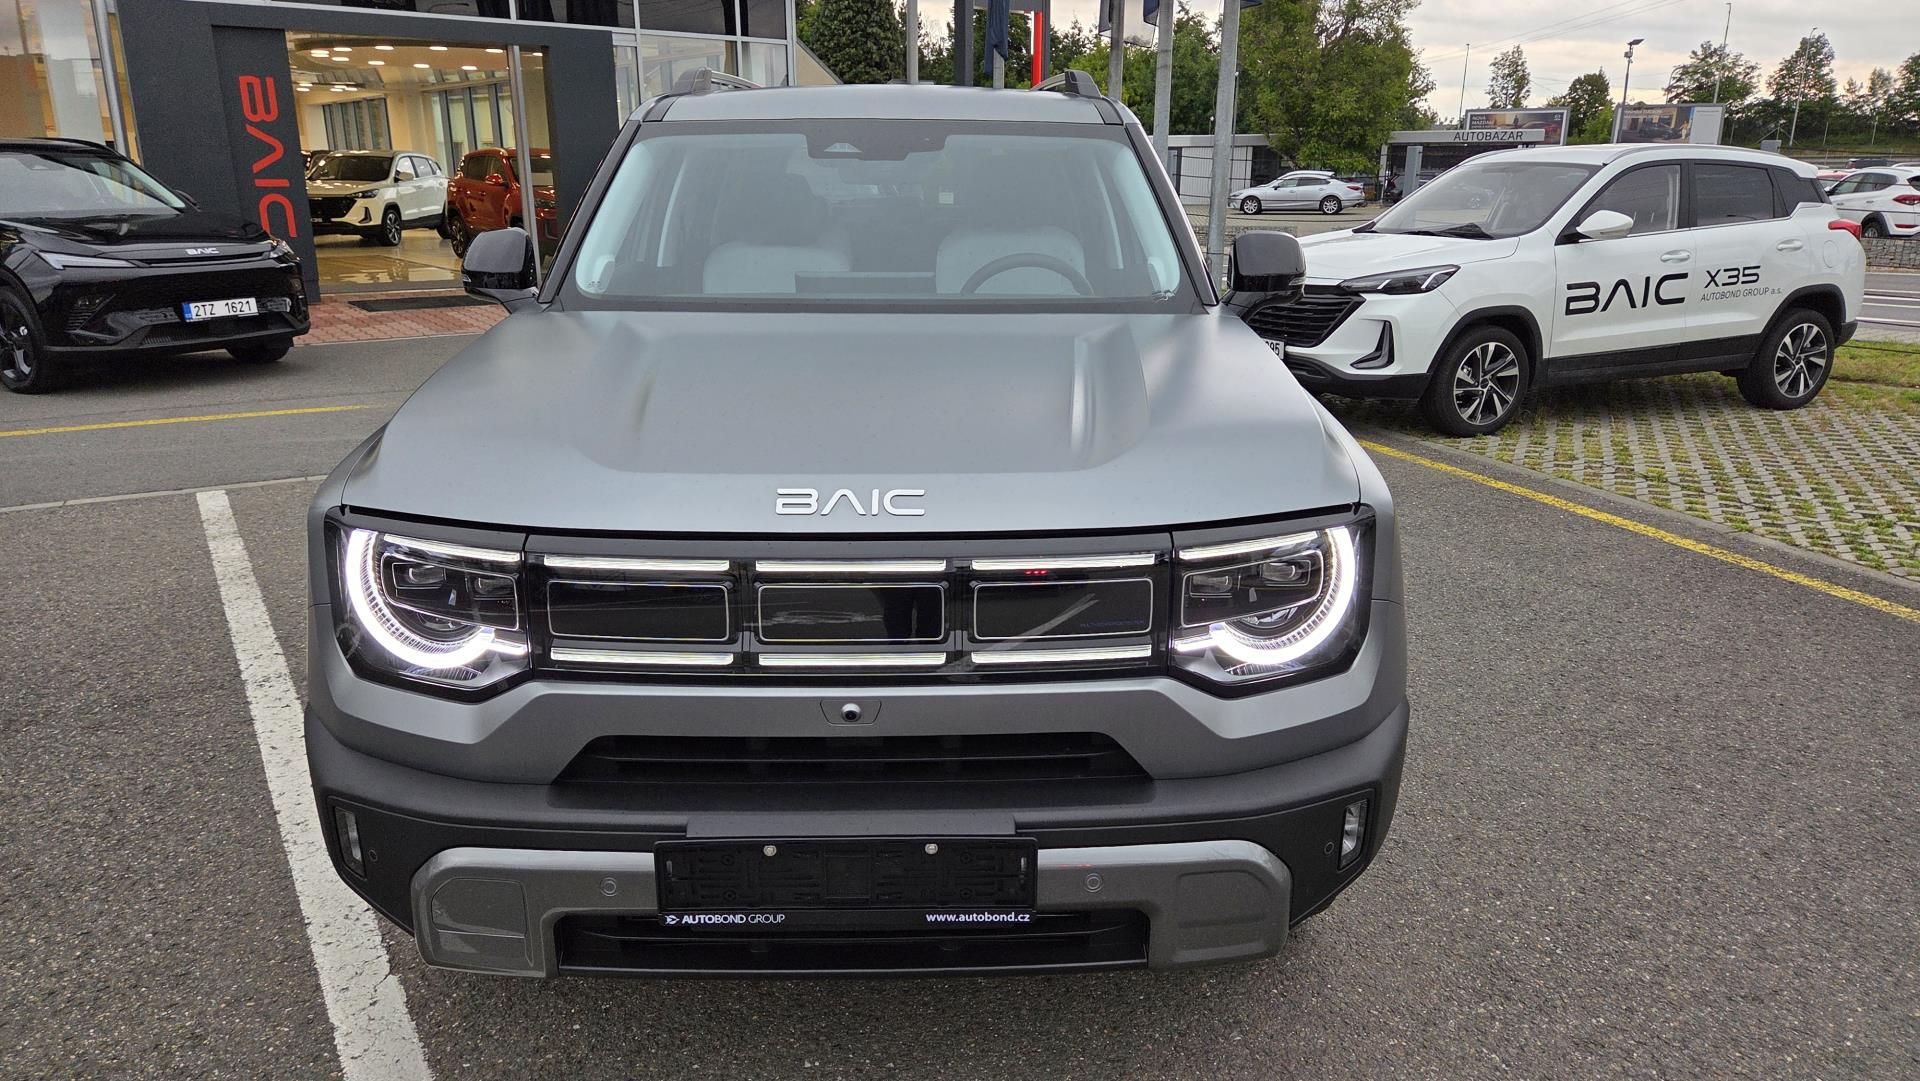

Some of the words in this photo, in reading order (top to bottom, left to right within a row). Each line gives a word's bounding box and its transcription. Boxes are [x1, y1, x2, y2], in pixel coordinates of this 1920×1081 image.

[1453, 131, 1524, 141] AUTOBAZAR
[239, 75, 297, 239] BAIC
[1565, 272, 1689, 316] BAIC
[1704, 265, 1761, 289] X35
[1701, 289, 1741, 301] AUTOBOND
[1742, 287, 1769, 297] GROUP
[193, 303, 217, 317] 2TZ
[224, 300, 252, 314] 1621
[775, 488, 925, 516] BAIC
[682, 914, 746, 924] AUTOBOND
[747, 913, 786, 924] GROUP
[925, 911, 1031, 922] www.autobond.cz
